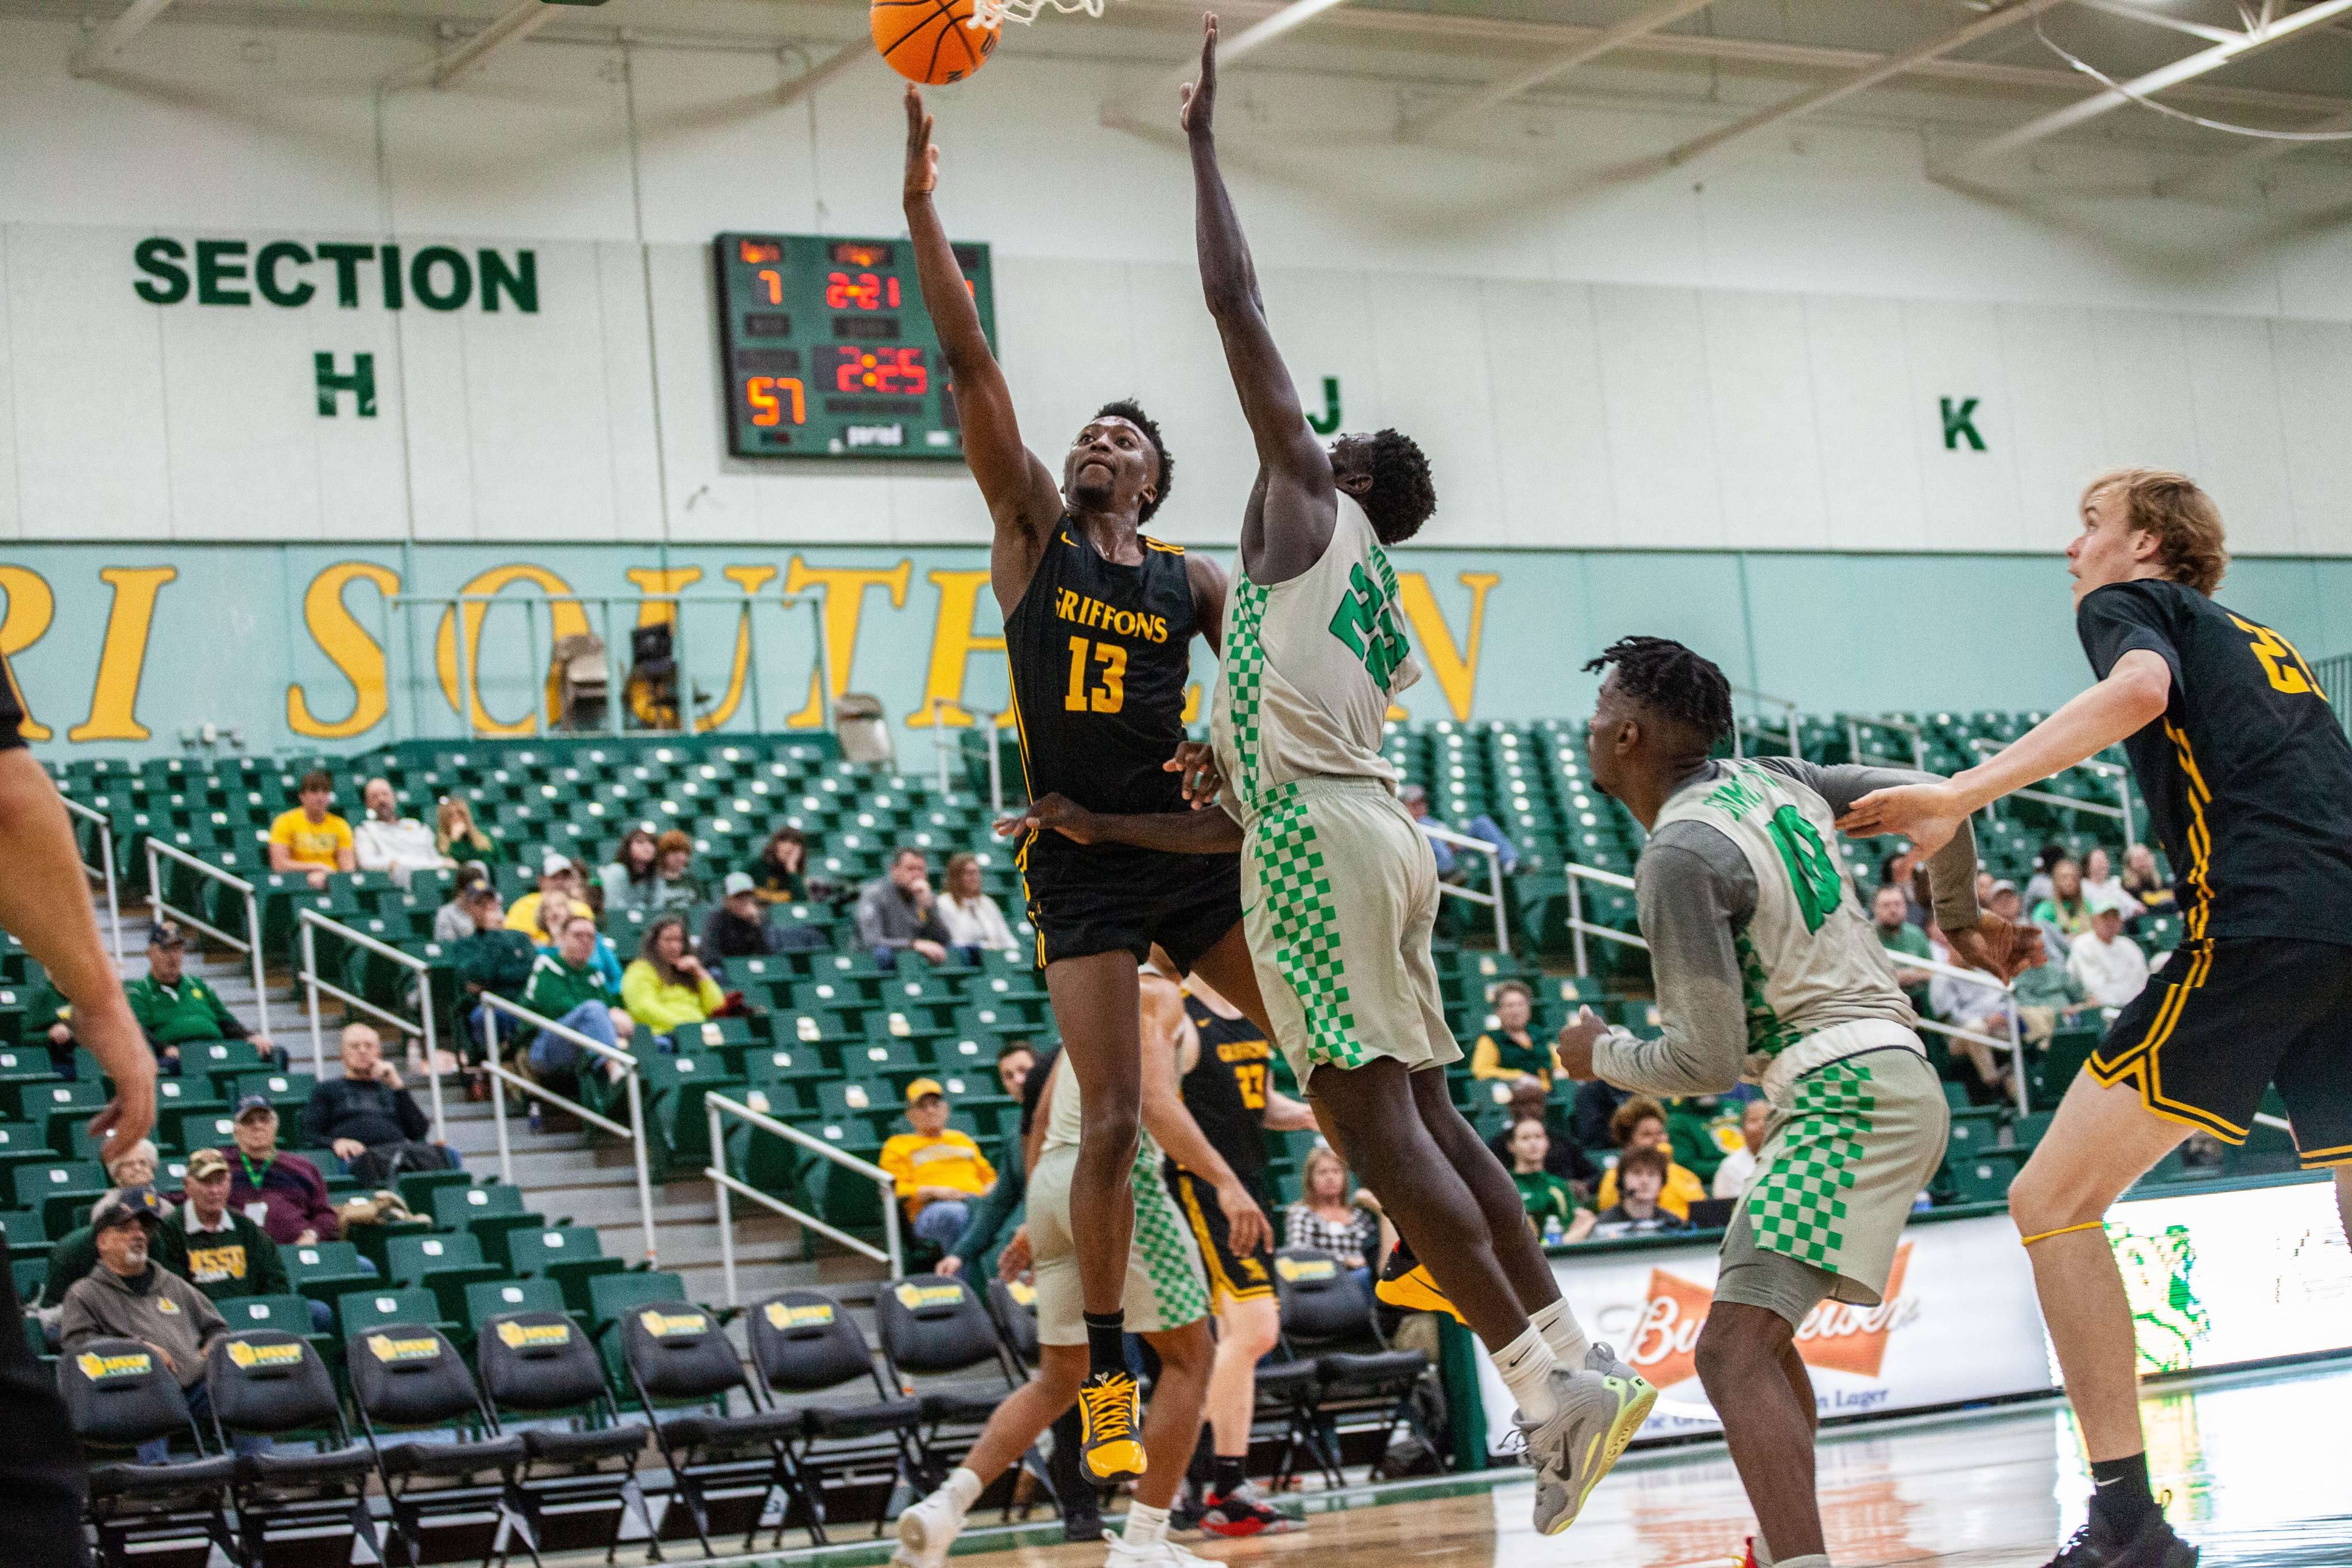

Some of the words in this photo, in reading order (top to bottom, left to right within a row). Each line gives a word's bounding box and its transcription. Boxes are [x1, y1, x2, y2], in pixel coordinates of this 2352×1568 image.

[133, 237, 539, 313] SECTION
[759, 269, 783, 305] 7
[314, 352, 378, 417] H
[836, 346, 928, 395] 2:25
[747, 377, 806, 426] 57
[1306, 377, 1341, 435] J
[1939, 396, 1988, 451] K
[1065, 636, 1127, 714] 13
